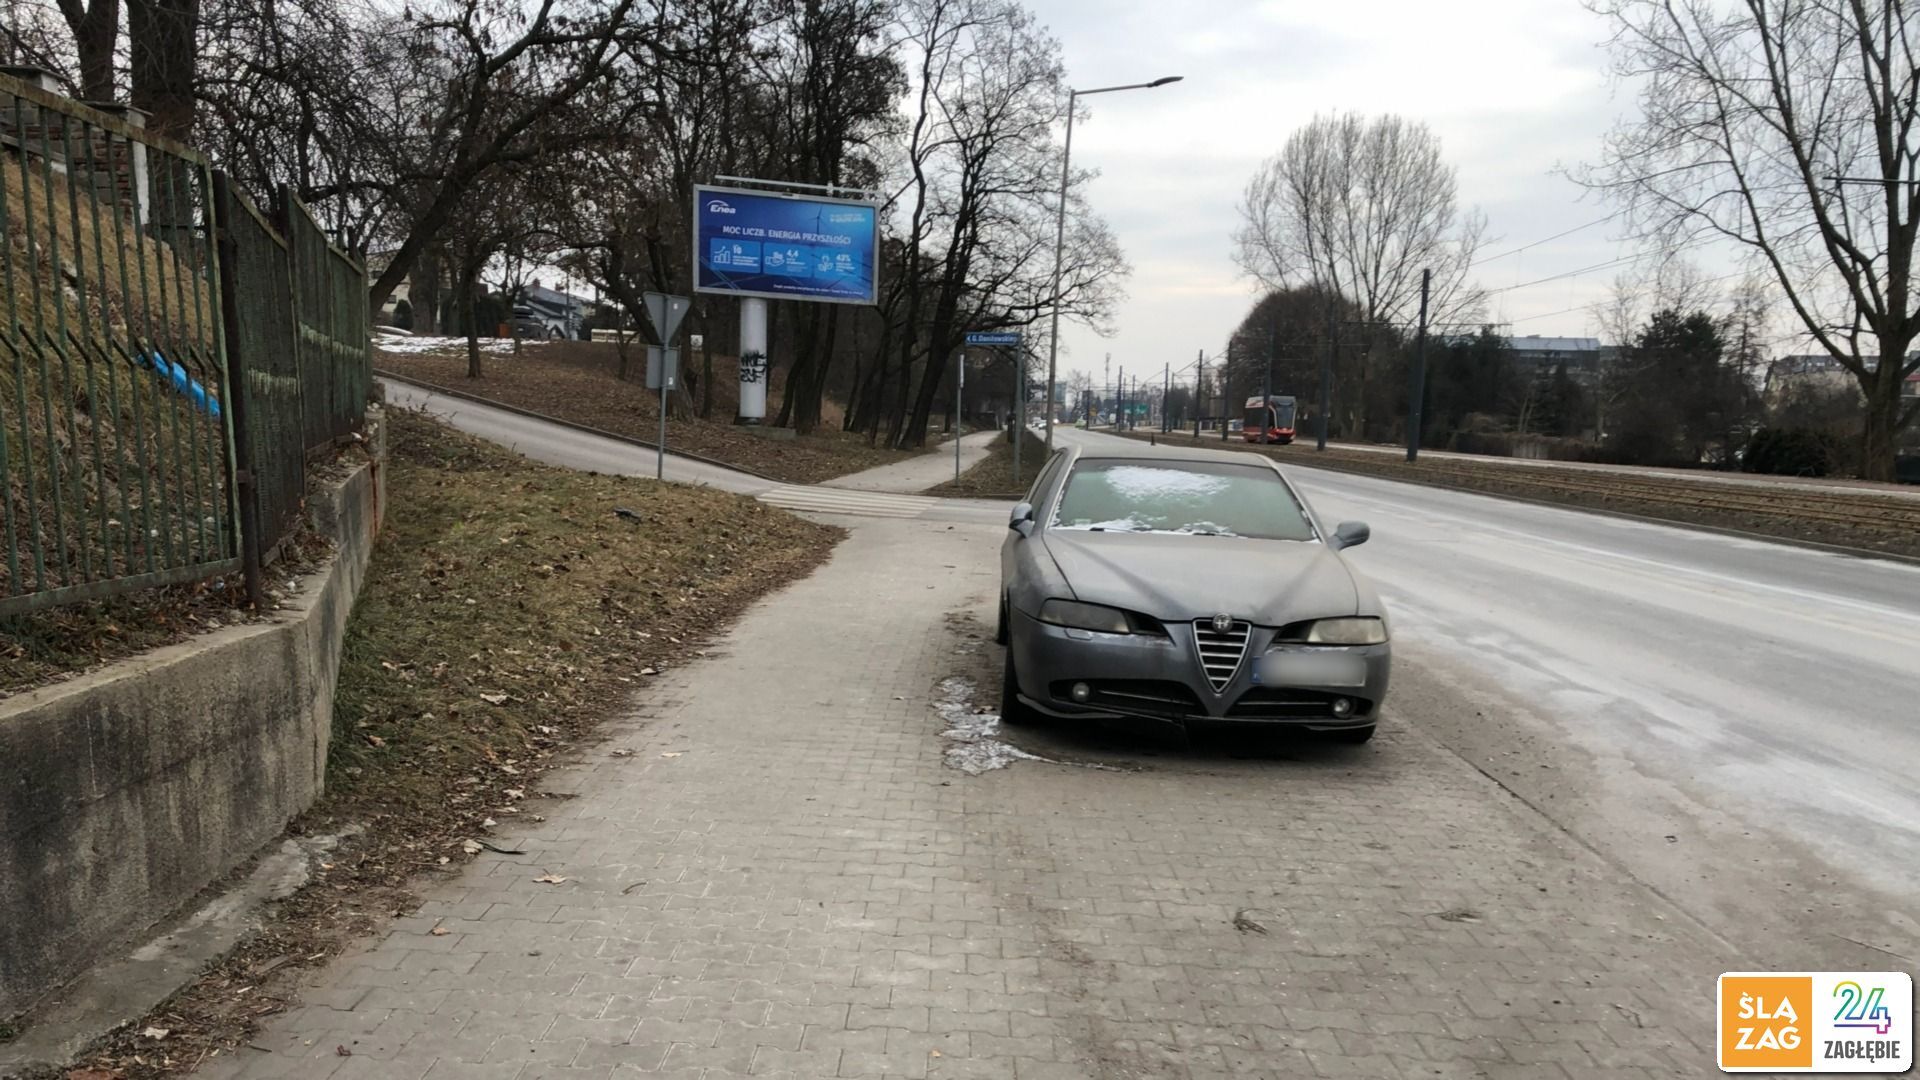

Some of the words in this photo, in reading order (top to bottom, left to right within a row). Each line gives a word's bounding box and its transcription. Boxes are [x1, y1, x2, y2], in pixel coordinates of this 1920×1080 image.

[710, 204, 736, 214] Enea
[722, 225, 741, 235] MOC
[742, 227, 767, 237] LICZB.
[768, 229, 801, 240] ENERGIA
[802, 232, 851, 245] PRZYSZŁOŚCI
